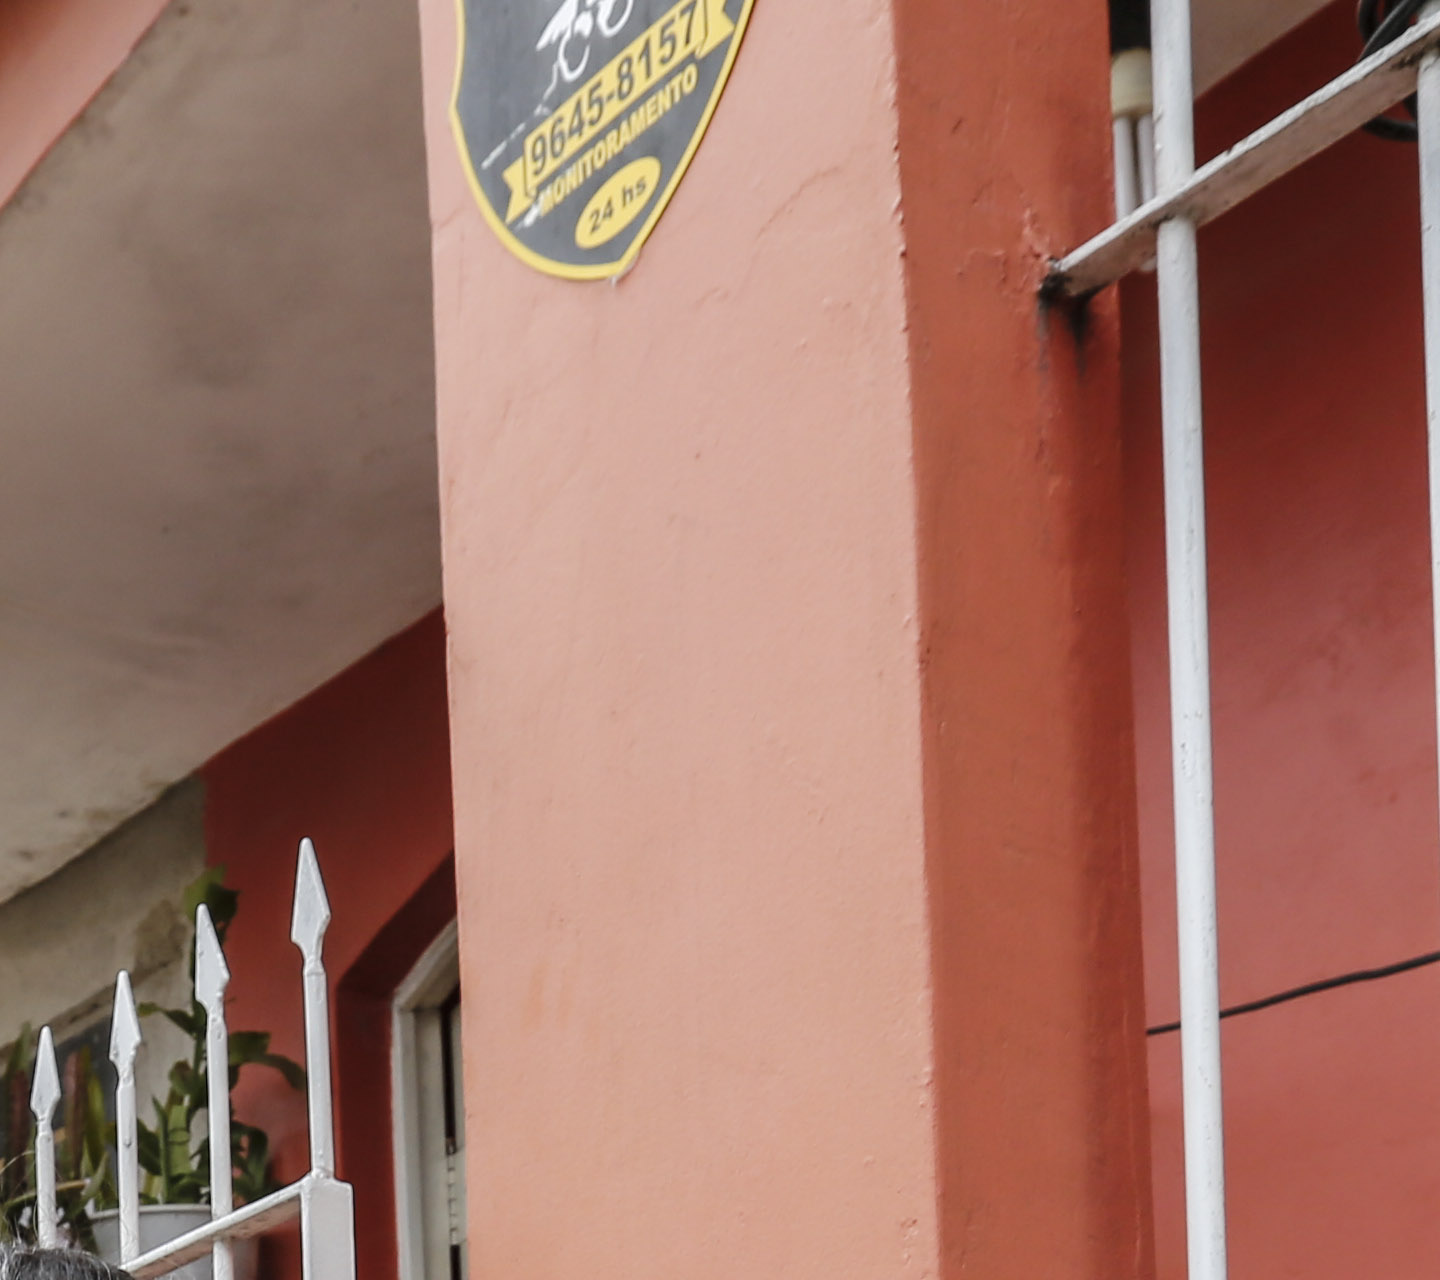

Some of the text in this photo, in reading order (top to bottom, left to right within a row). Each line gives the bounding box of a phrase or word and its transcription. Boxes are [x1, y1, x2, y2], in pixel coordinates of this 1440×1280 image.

[530, 3, 698, 177] 9645-8157
[540, 63, 698, 217] MONITORAMENTO
[588, 198, 614, 235] 24
